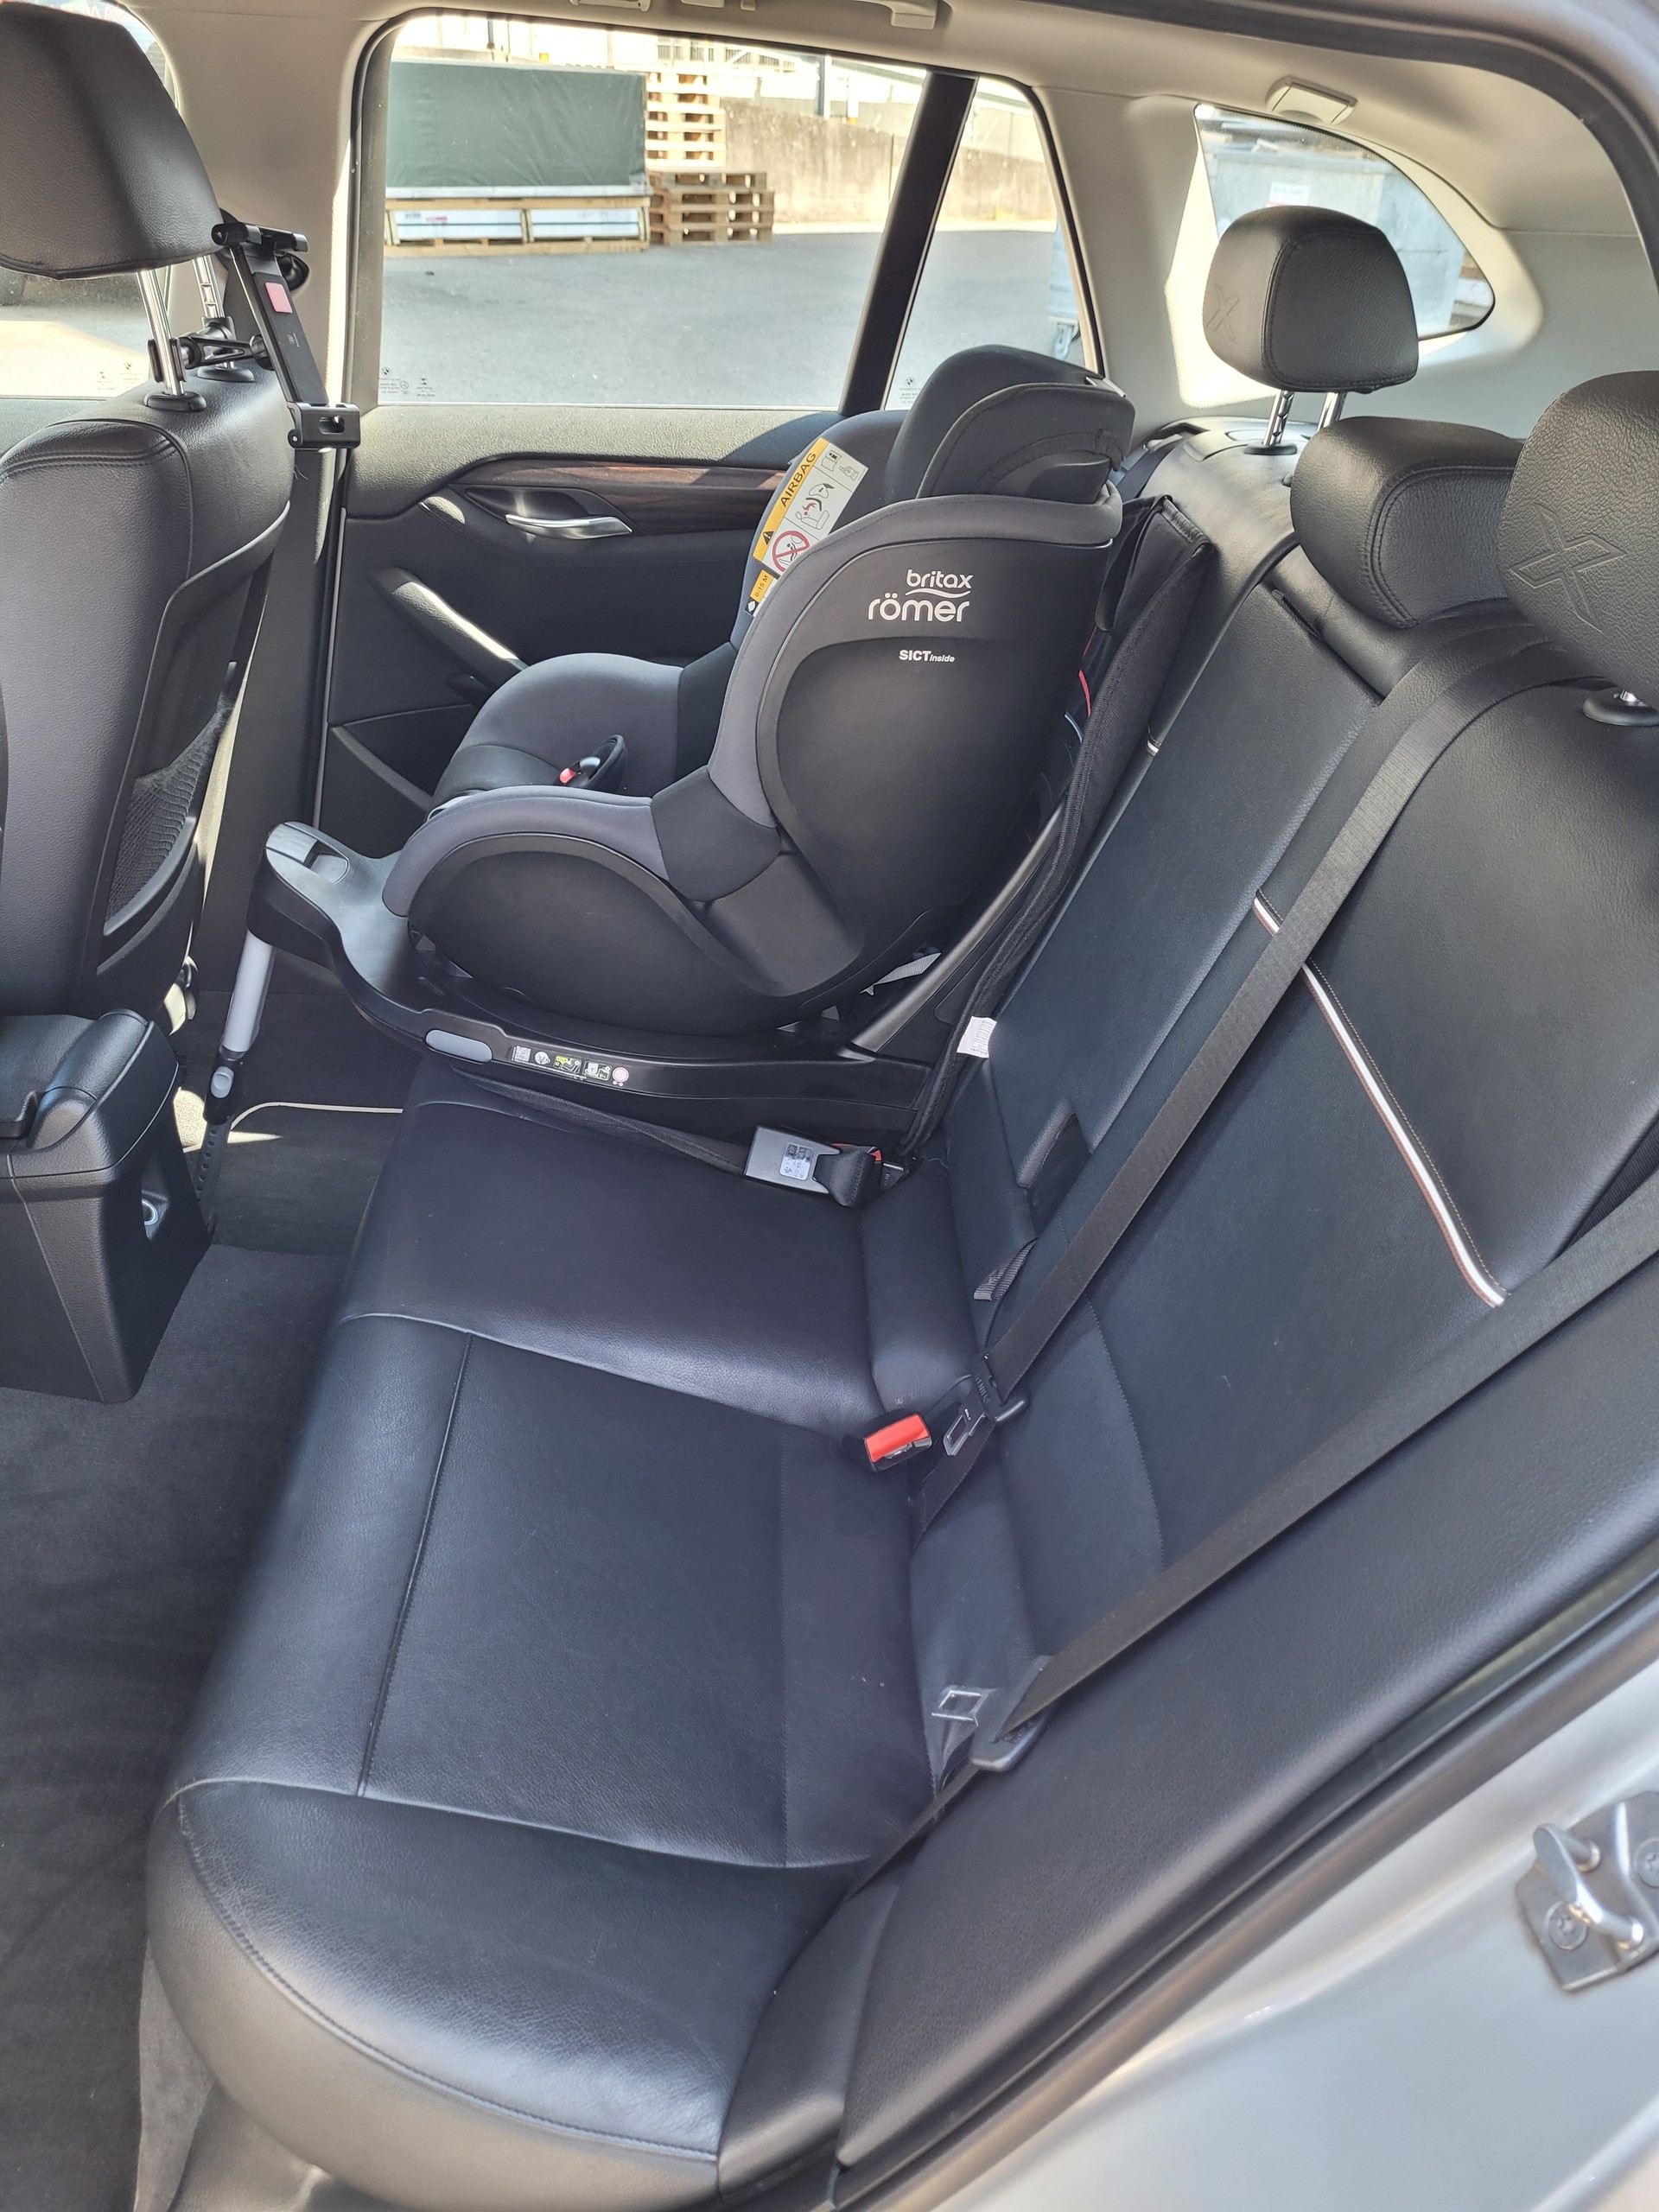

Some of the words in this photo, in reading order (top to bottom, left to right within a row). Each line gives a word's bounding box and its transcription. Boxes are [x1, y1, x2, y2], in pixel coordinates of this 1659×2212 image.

[780, 452, 817, 508] AIRBAG
[906, 569, 973, 589] britax
[868, 592, 970, 622] römer
